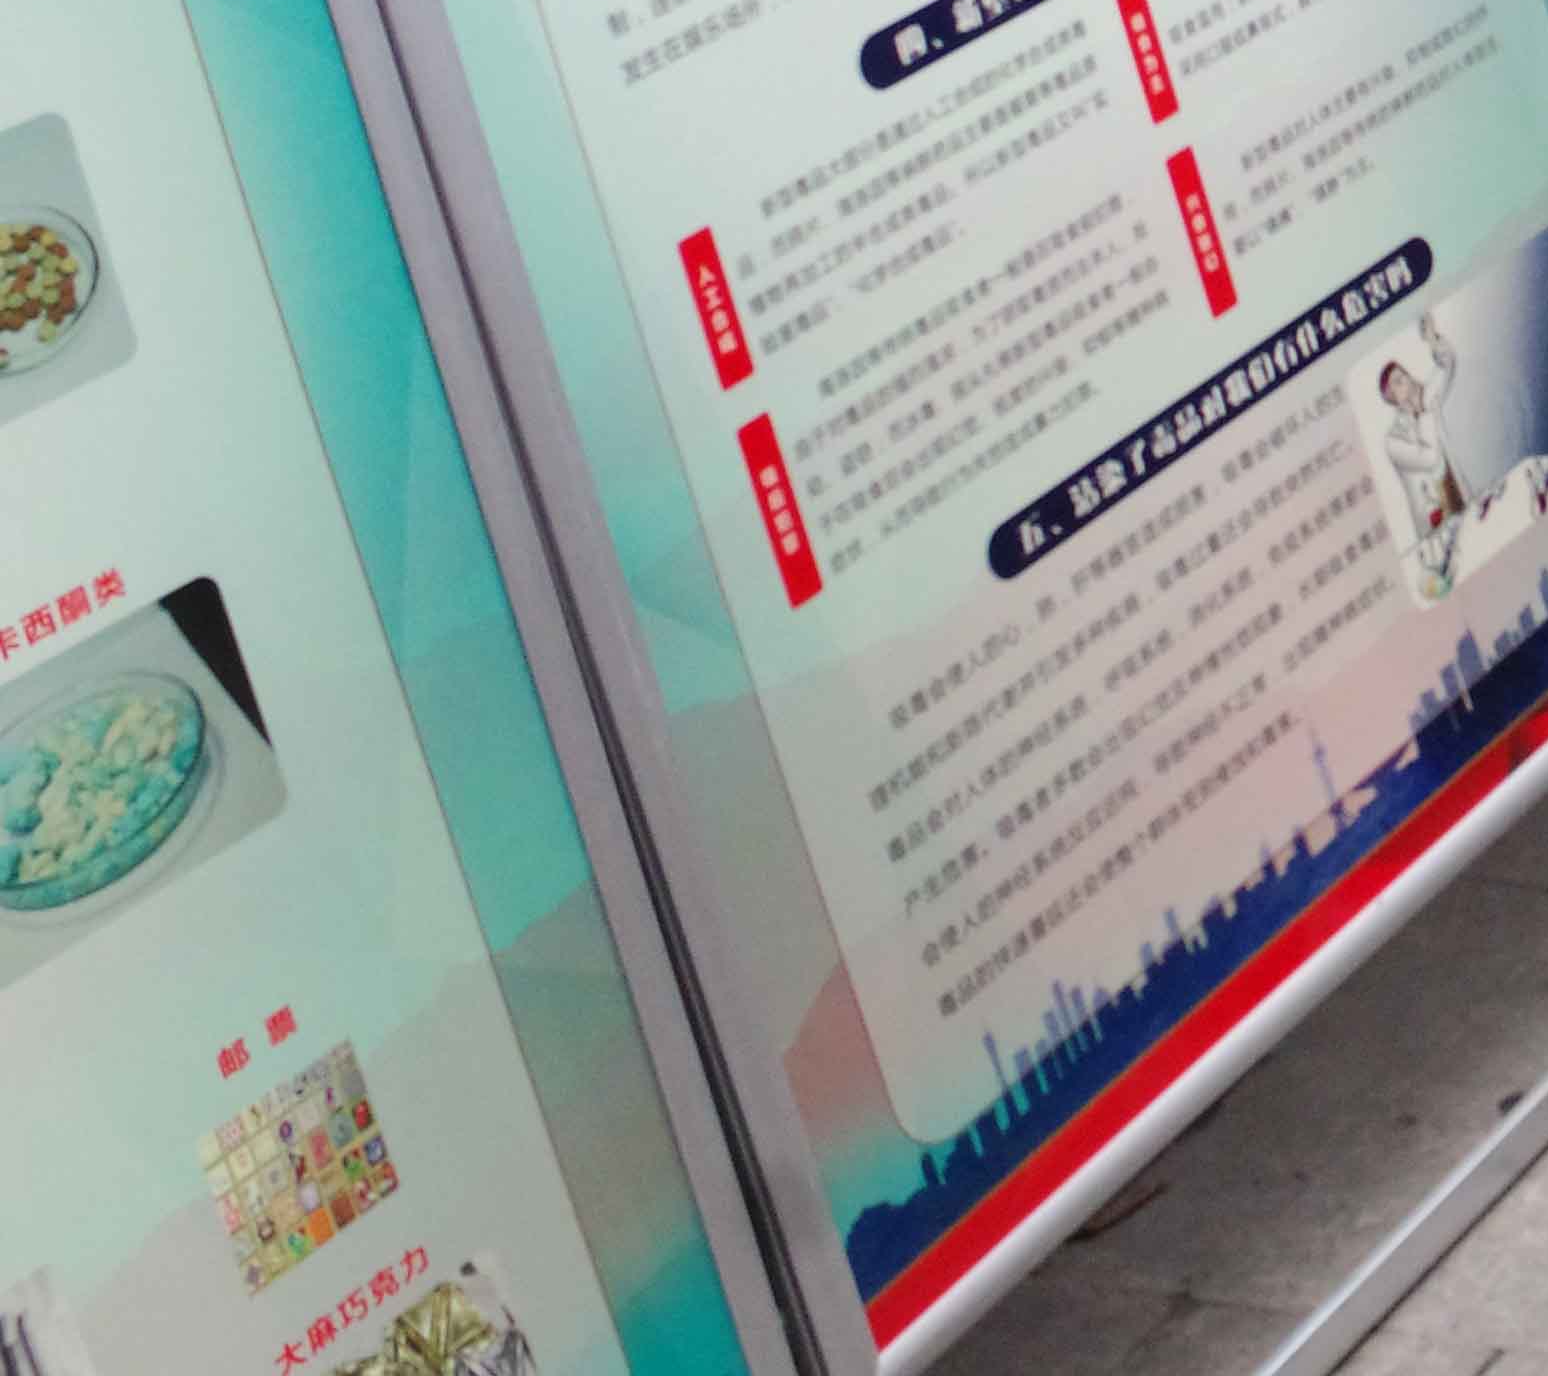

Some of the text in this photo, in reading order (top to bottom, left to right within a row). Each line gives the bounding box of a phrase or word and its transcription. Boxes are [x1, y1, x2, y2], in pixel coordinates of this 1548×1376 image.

[273, 1244, 430, 1376] 大麻巧克力
